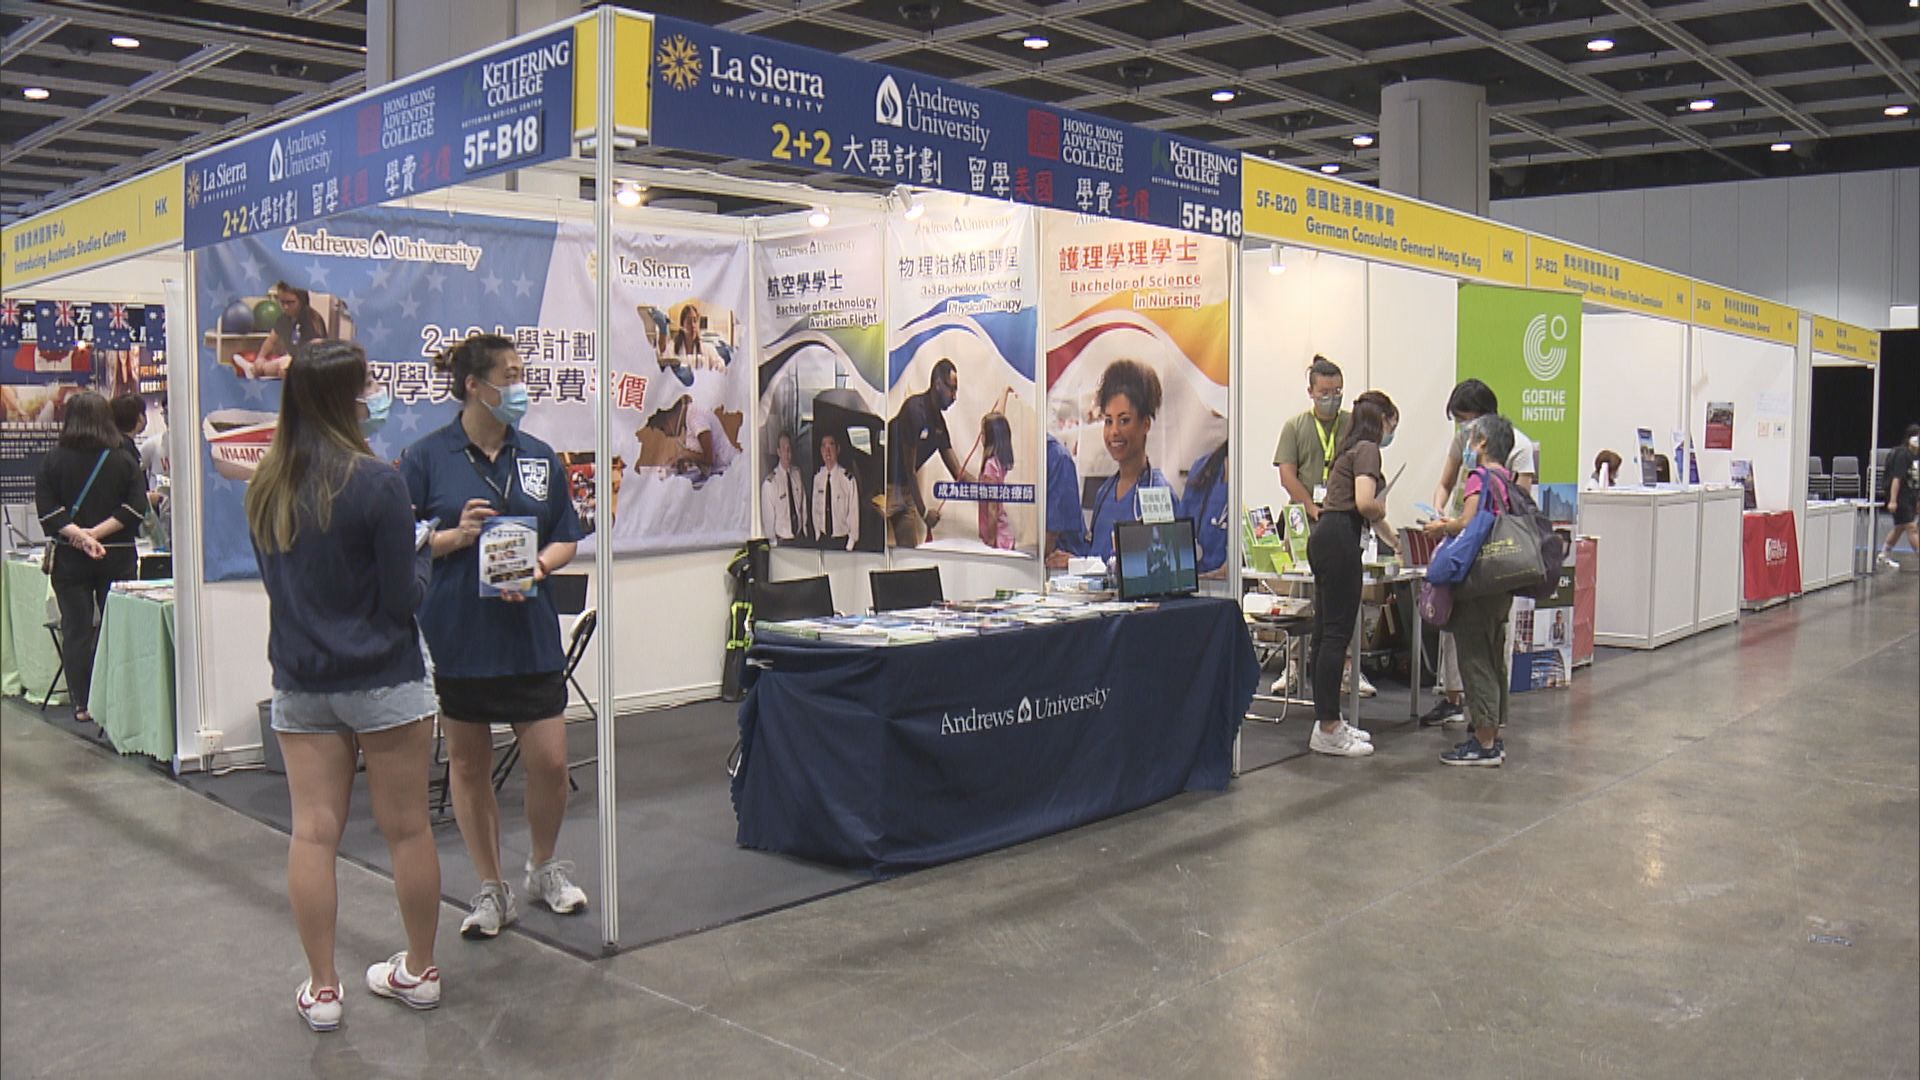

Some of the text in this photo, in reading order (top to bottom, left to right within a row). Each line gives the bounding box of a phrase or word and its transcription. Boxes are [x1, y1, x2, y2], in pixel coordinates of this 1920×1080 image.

[482, 40, 570, 92] KETTERING
[710, 46, 825, 99] La Sierra
[383, 86, 435, 116] HONG KONG
[487, 73, 544, 108] COLLEGE
[712, 83, 824, 114] UNIVERSITY
[906, 82, 980, 120] Andrews
[383, 101, 435, 133] ADVENTIST
[907, 105, 990, 151] University
[1063, 118, 1124, 144] HONG KONG
[284, 129, 327, 157] Andrews
[382, 117, 435, 150] COLLEGE
[463, 114, 538, 170] 5F-B18
[1063, 134, 1124, 158] ADVENTIST
[284, 149, 333, 180] University
[771, 122, 1149, 220] 2+2 大學計劃 留學美國 學費半價
[1062, 146, 1124, 174] COLLEGE
[1169, 140, 1238, 176] KETTERING
[203, 161, 247, 192] La Sierra
[1174, 162, 1220, 187] COLLEGE
[155, 196, 168, 217] HK
[1256, 189, 1297, 215] 5F-B20
[1181, 201, 1242, 237] 5F-B18
[47, 242, 75, 264] Australia
[77, 234, 101, 255] Studies
[102, 229, 127, 248] Centre
[285, 229, 480, 268] Andrews University
[1058, 236, 1198, 272] 護理學理學士
[1306, 215, 1483, 272] German Consulate General Hong Kong
[1503, 249, 1514, 263] HK
[619, 256, 691, 280] La Sierra
[767, 268, 843, 298] 航空學學士
[1010, 276, 1020, 288] of
[1071, 273, 1201, 294] Bachelor of Science
[776, 296, 877, 315] Bachelor of Technology
[985, 299, 1021, 312] Therapy
[1134, 293, 1201, 308] in Nursing
[810, 312, 877, 328] Aviation Flight
[1522, 389, 1566, 405] GOETHE
[1522, 406, 1566, 422] INSTITUT
[941, 687, 1111, 736] Andrews University
